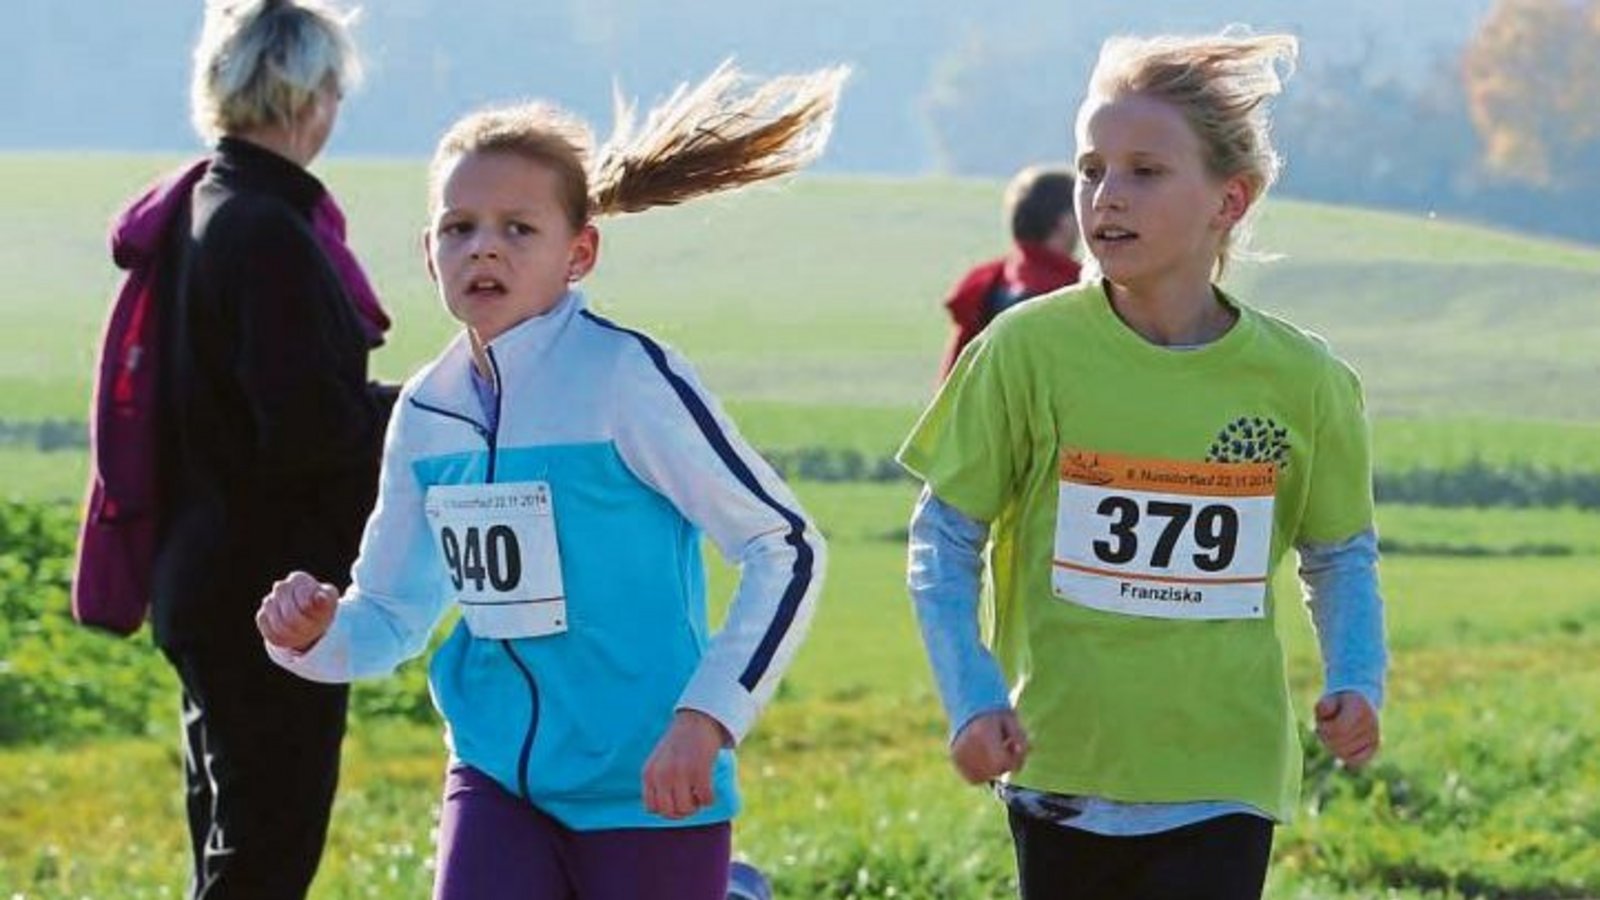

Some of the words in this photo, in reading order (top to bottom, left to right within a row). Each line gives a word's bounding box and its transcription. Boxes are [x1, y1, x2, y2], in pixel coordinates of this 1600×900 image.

[441, 524, 522, 592] 940
[1092, 496, 1239, 572] 379
[1120, 582, 1202, 603] Franziska
